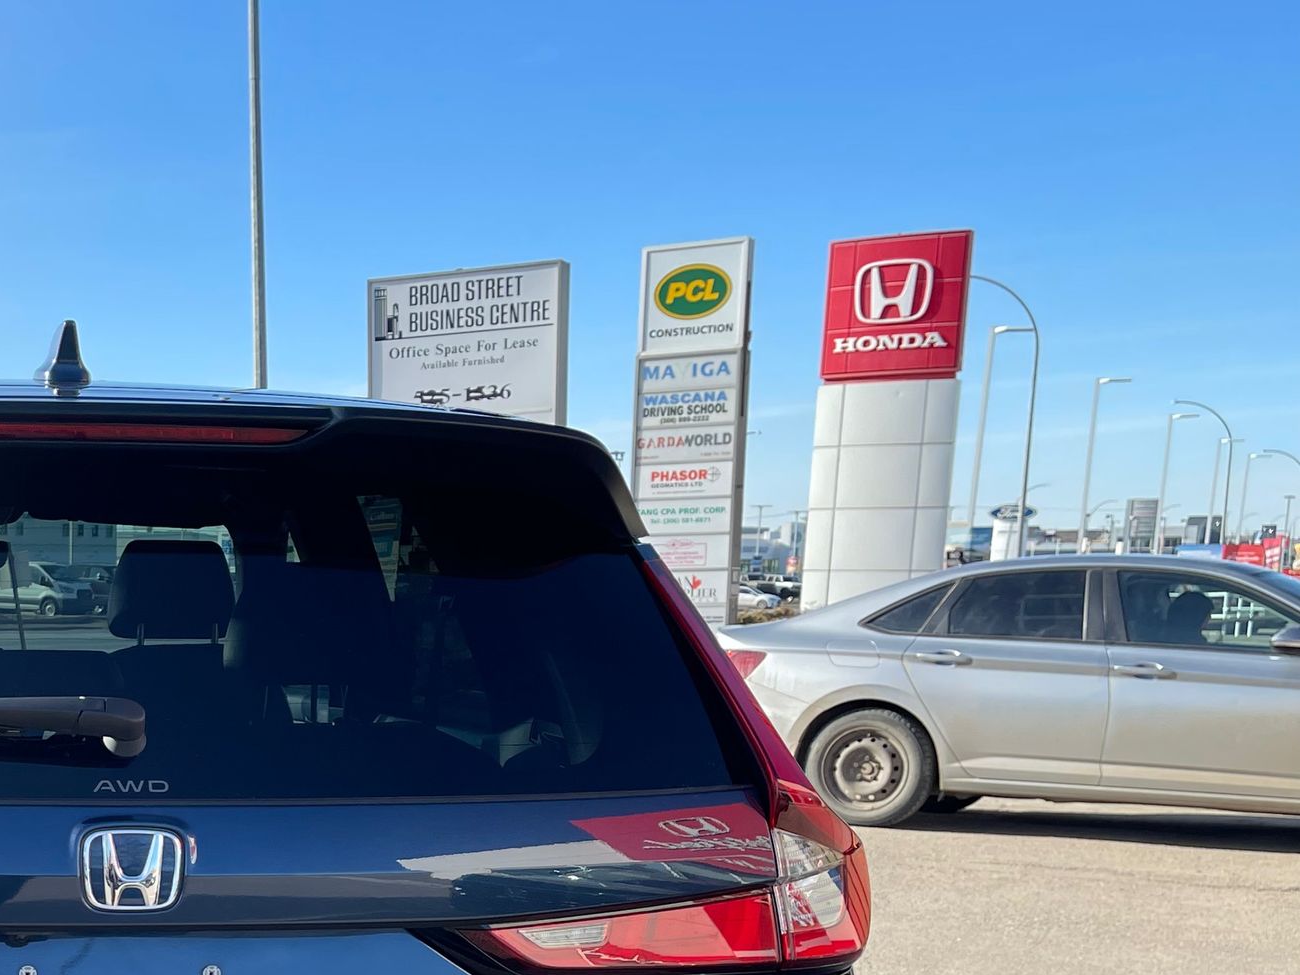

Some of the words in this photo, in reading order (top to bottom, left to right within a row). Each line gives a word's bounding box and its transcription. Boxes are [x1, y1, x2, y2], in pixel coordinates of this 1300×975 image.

[409, 281, 460, 306] BROAD
[465, 275, 523, 301] STREET
[665, 278, 720, 305] PCL
[409, 306, 485, 333] BUSINESS
[490, 299, 551, 326] CENTRE
[649, 322, 734, 339] CONSTRUCTION
[388, 345, 430, 360] Office
[435, 342, 471, 358] Space
[476, 339, 498, 352] For
[503, 336, 539, 350] Lease
[832, 331, 948, 354] HONDA
[420, 359, 459, 371] Available
[462, 354, 505, 367] Furnished
[643, 390, 728, 406] WASCANA
[643, 405, 684, 418] DRIVING
[686, 402, 729, 416] SCHOOL
[636, 432, 732, 450] GARDAWORLD
[651, 469, 709, 482] PHASOR
[650, 481, 689, 489] GEOMATICS
[660, 507, 677, 515] CPA
[93, 779, 170, 793] AWD
